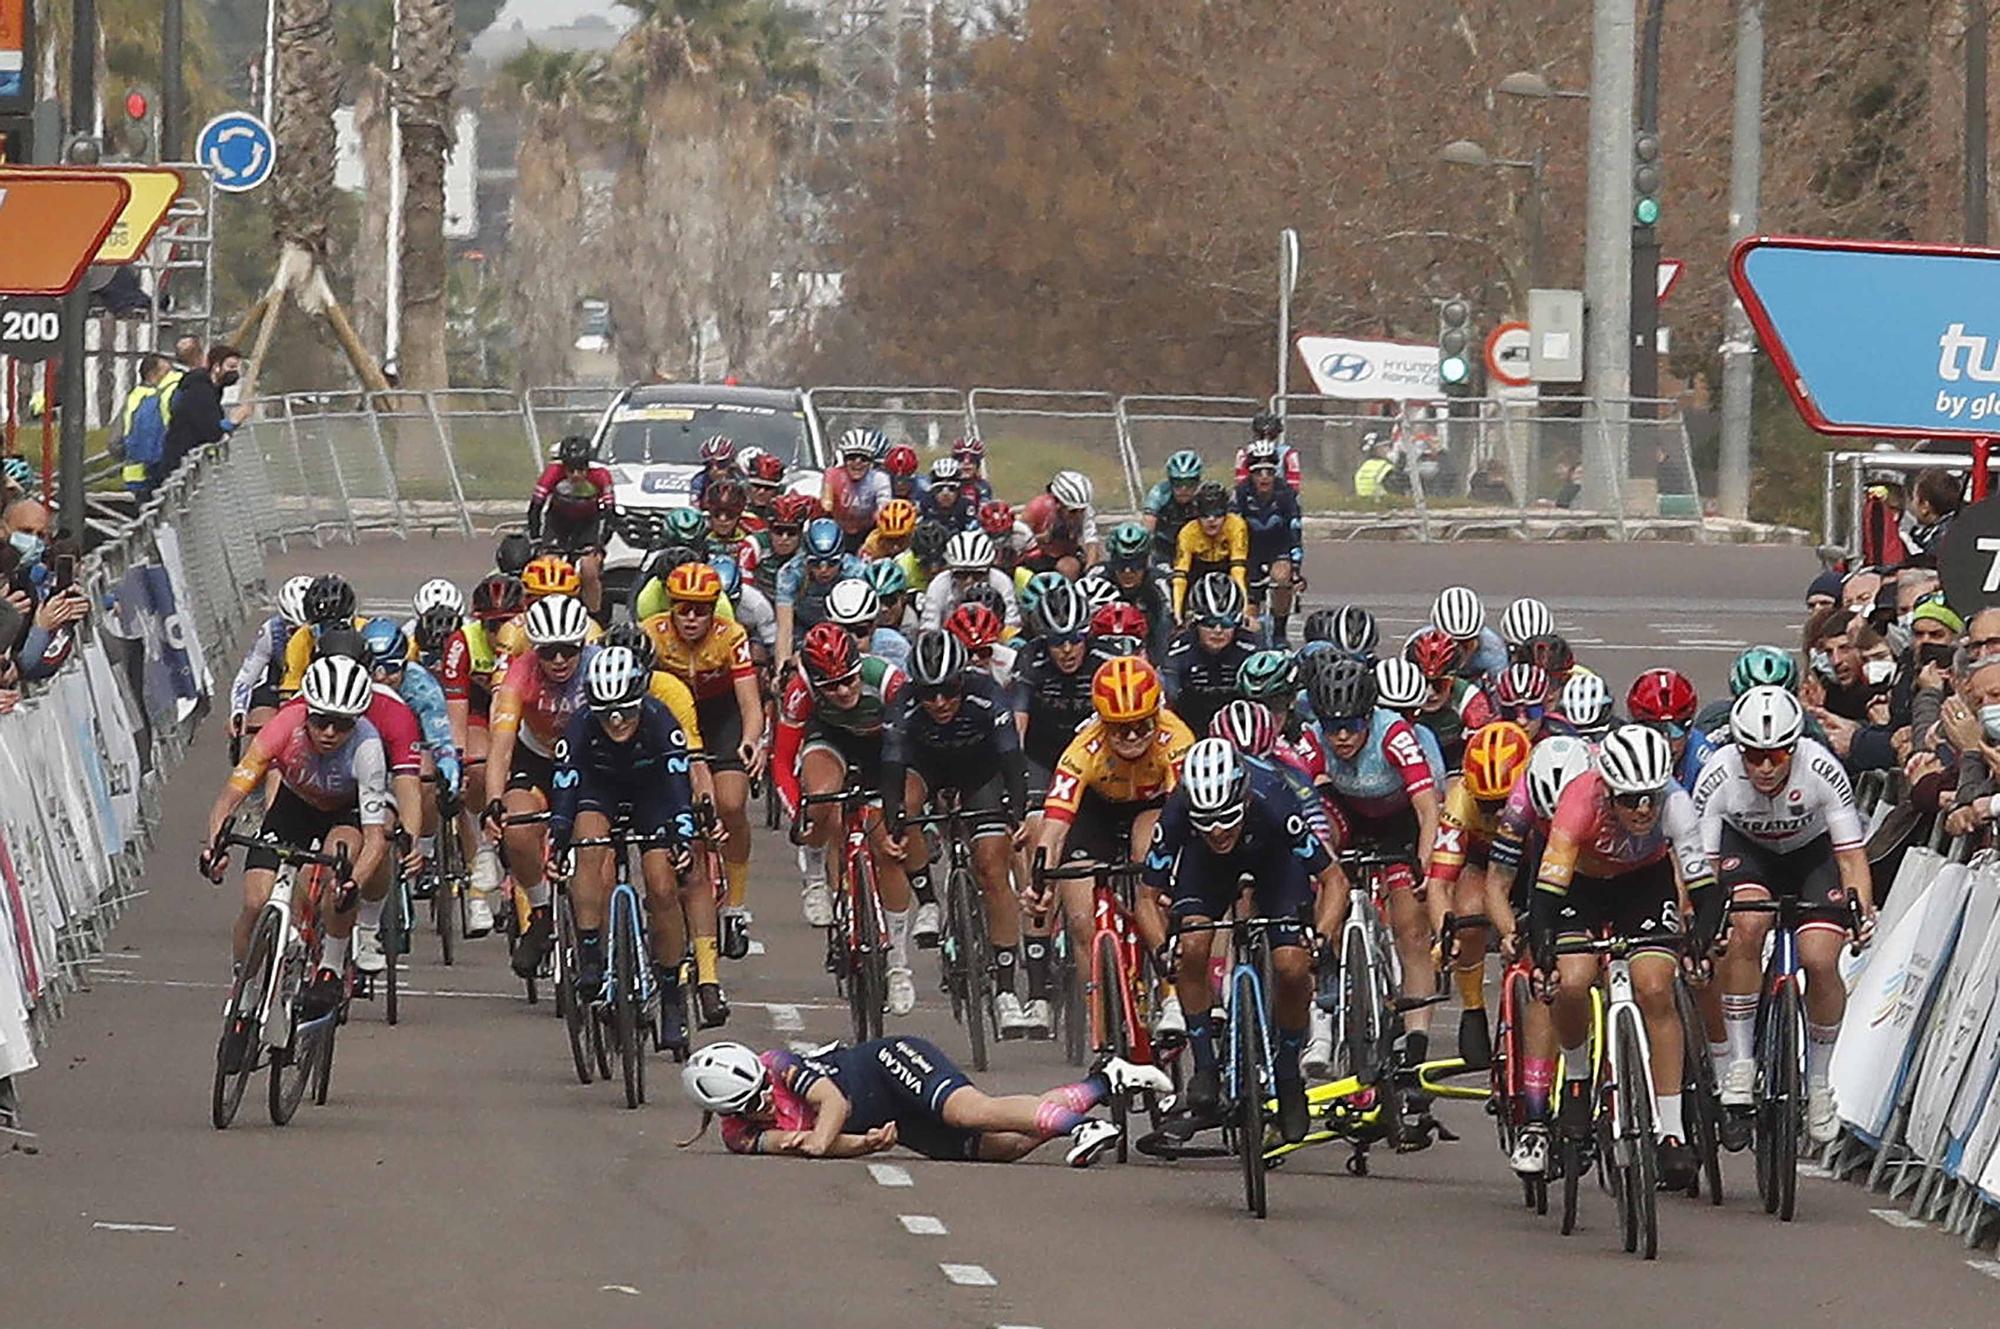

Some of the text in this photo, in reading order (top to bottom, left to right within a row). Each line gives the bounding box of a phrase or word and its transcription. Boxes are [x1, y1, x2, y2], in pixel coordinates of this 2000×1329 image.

[2, 310, 60, 341] 200
[1936, 390, 1967, 418] by
[878, 1047, 923, 1094] VALCAR
